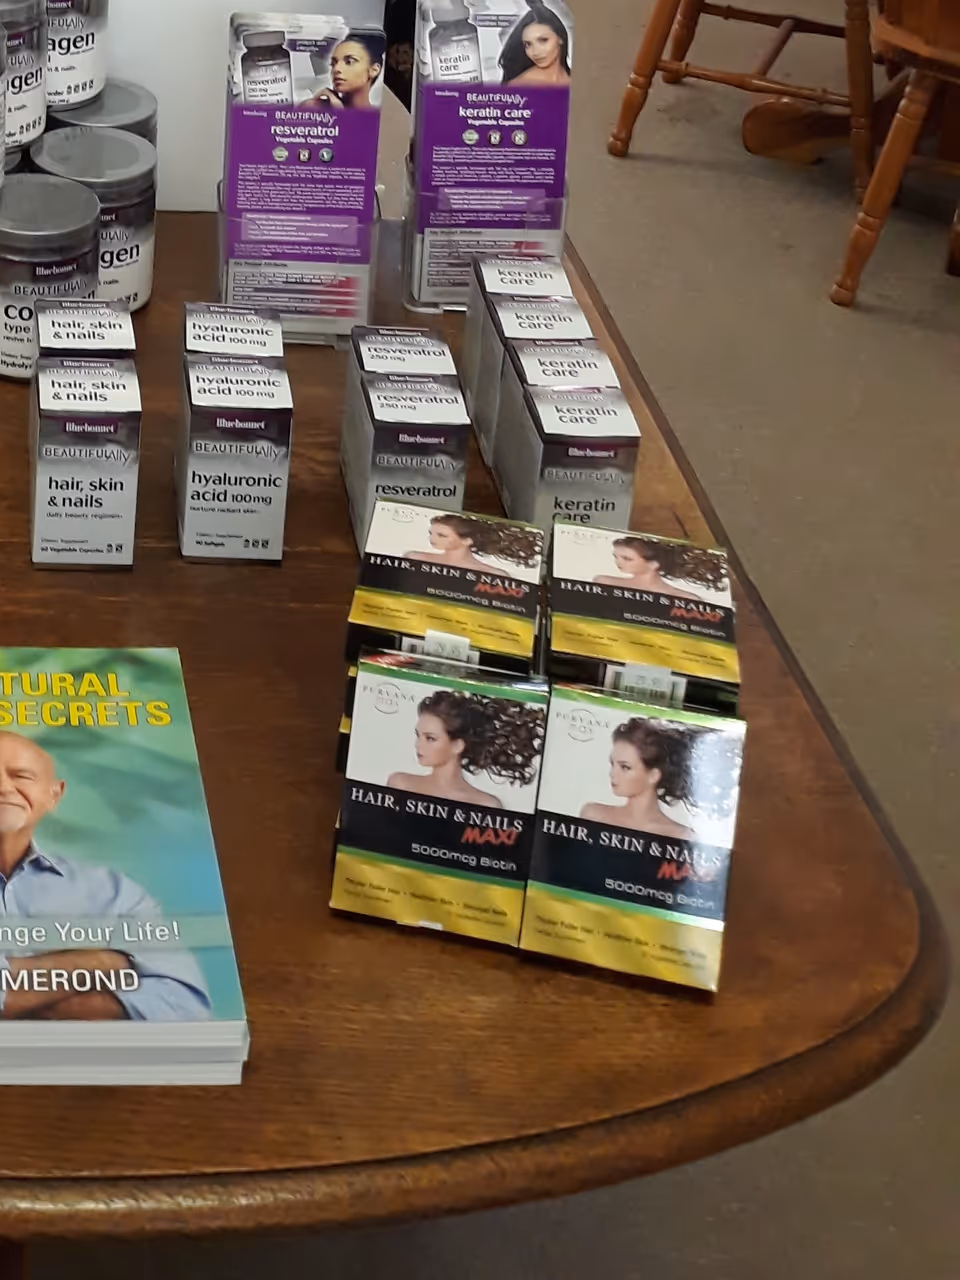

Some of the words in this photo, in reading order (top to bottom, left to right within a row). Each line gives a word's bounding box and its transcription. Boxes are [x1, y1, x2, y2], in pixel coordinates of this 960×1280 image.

[438, 53, 470, 65] keratin
[459, 106, 501, 118] keratin
[504, 108, 531, 118] care
[271, 125, 339, 136] resveratrol
[100, 243, 140, 269] gen
[497, 268, 553, 280] keratin
[500, 277, 536, 286] care
[4, 304, 34, 321] co
[514, 312, 573, 323] keratin
[4, 322, 31, 334] type
[51, 319, 85, 330] hair,
[89, 320, 123, 330] skin
[192, 322, 274, 337] hyaluronic
[518, 321, 554, 330] care
[52, 331, 62, 340] &
[66, 330, 106, 340] nails
[192, 333, 226, 343] acid
[249, 338, 267, 347] mg
[367, 346, 447, 358] resveratrol
[537, 358, 599, 369] keratin
[541, 368, 580, 378] care
[51, 379, 87, 391] hair,
[91, 381, 126, 391] skin
[195, 375, 282, 388] hyaluronic
[52, 391, 63, 401] &
[66, 391, 108, 402] nails
[197, 386, 232, 395] acid
[235, 389, 255, 397] 100
[256, 391, 275, 399] mg
[376, 394, 460, 405] resveratrol
[554, 405, 619, 417] keratin
[216, 417, 266, 429] Bluebonnet
[558, 415, 598, 425] care
[65, 421, 114, 433] Bluebonnet
[48, 476, 84, 493] hair,
[88, 477, 124, 492] skin
[191, 470, 283, 488] hyaluronic
[190, 488, 228, 502] acid
[375, 483, 457, 498] resveratrol
[47, 495, 59, 508] &
[62, 494, 103, 508] nails
[553, 496, 616, 512] keratin
[551, 512, 591, 524] care
[369, 555, 416, 572] HAIR,
[420, 564, 461, 578] SKIN
[466, 572, 477, 581] &
[480, 574, 531, 593] NAILS
[560, 581, 608, 596] HAIR,
[613, 588, 654, 602] SKIN
[658, 596, 671, 606] &
[674, 599, 726, 617] NAILS
[491, 600, 527, 613] Biotin
[362, 685, 416, 703] PURVANA
[351, 787, 400, 812] HAIR,
[405, 798, 449, 820] SKIN
[453, 809, 467, 823] &
[469, 811, 524, 833] NAILS
[461, 826, 519, 846] MAXI
[542, 818, 593, 845] HAIR,
[599, 830, 644, 853] SKIN
[649, 842, 662, 858] &
[666, 844, 722, 868] NAILS
[411, 842, 477, 866] 5000mcg
[480, 857, 517, 871] Biotin
[604, 878, 674, 905] 5000mcg
[677, 894, 715, 910] Biotin
[54, 921, 114, 942] Your
[122, 920, 181, 942] Life!
